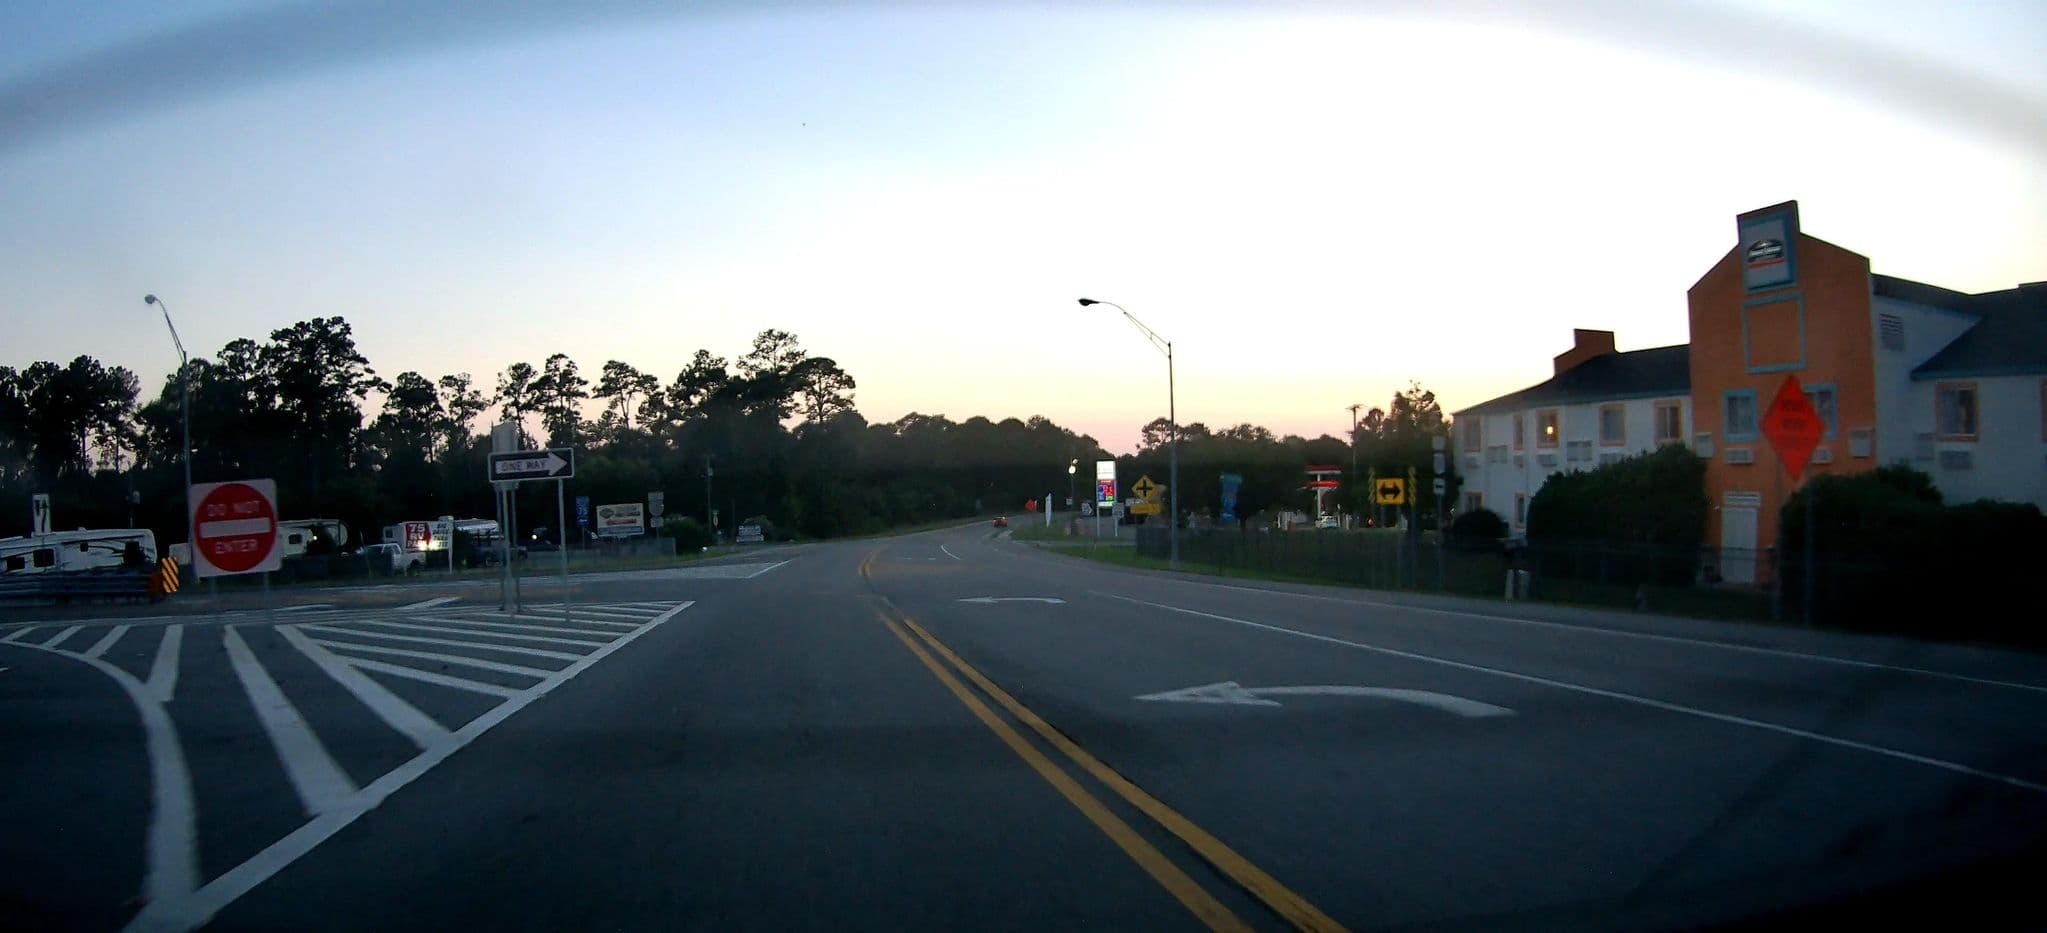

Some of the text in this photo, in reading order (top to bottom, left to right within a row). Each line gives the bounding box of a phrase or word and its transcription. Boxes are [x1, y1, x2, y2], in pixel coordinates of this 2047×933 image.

[501, 459, 546, 472] ONE WAY
[207, 500, 260, 517] DO NOT
[409, 523, 425, 532] 75
[410, 533, 425, 541] RV
[215, 540, 258, 554] ENTER
